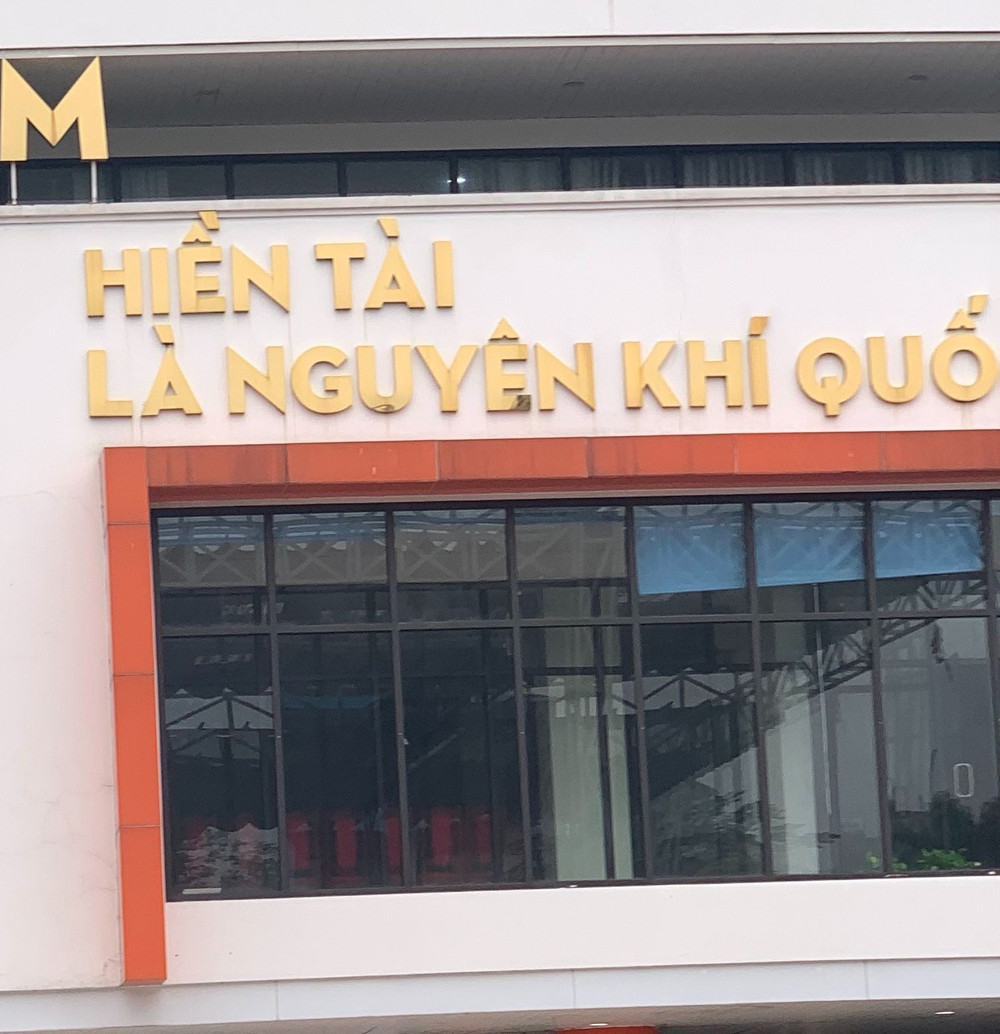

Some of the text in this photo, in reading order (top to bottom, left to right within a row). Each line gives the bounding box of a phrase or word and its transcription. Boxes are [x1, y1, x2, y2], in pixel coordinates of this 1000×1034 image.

[84, 210, 455, 318] HIỀN TÀI
[87, 294, 1000, 420] LÀ NGUYÊN KHÍ QUỐ
